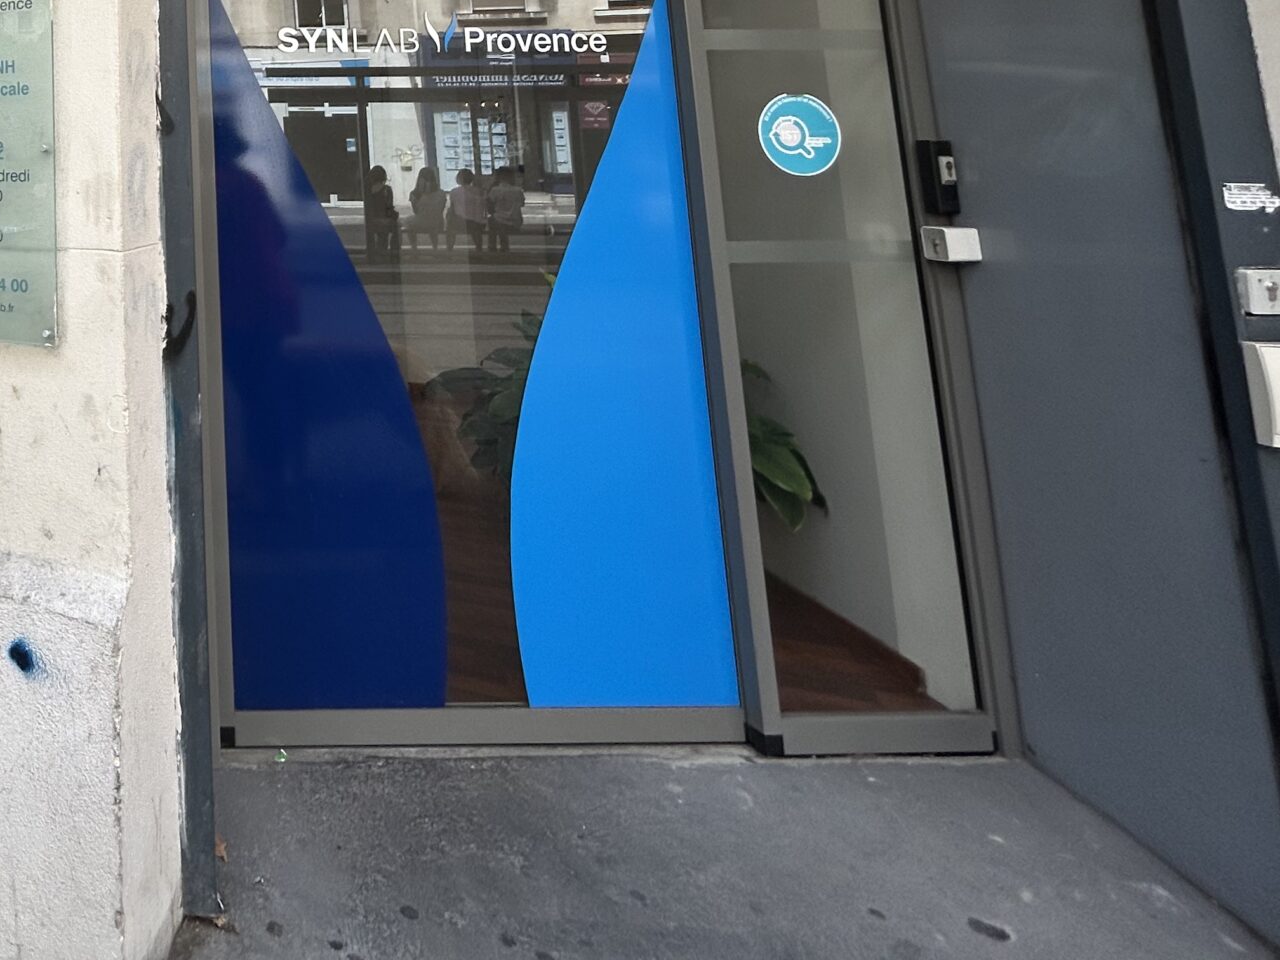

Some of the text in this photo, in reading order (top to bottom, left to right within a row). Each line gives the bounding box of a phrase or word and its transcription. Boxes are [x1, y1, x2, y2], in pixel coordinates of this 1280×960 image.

[277, 26, 608, 53] SYNLAB Provence
[11, 279, 28, 293] 00
